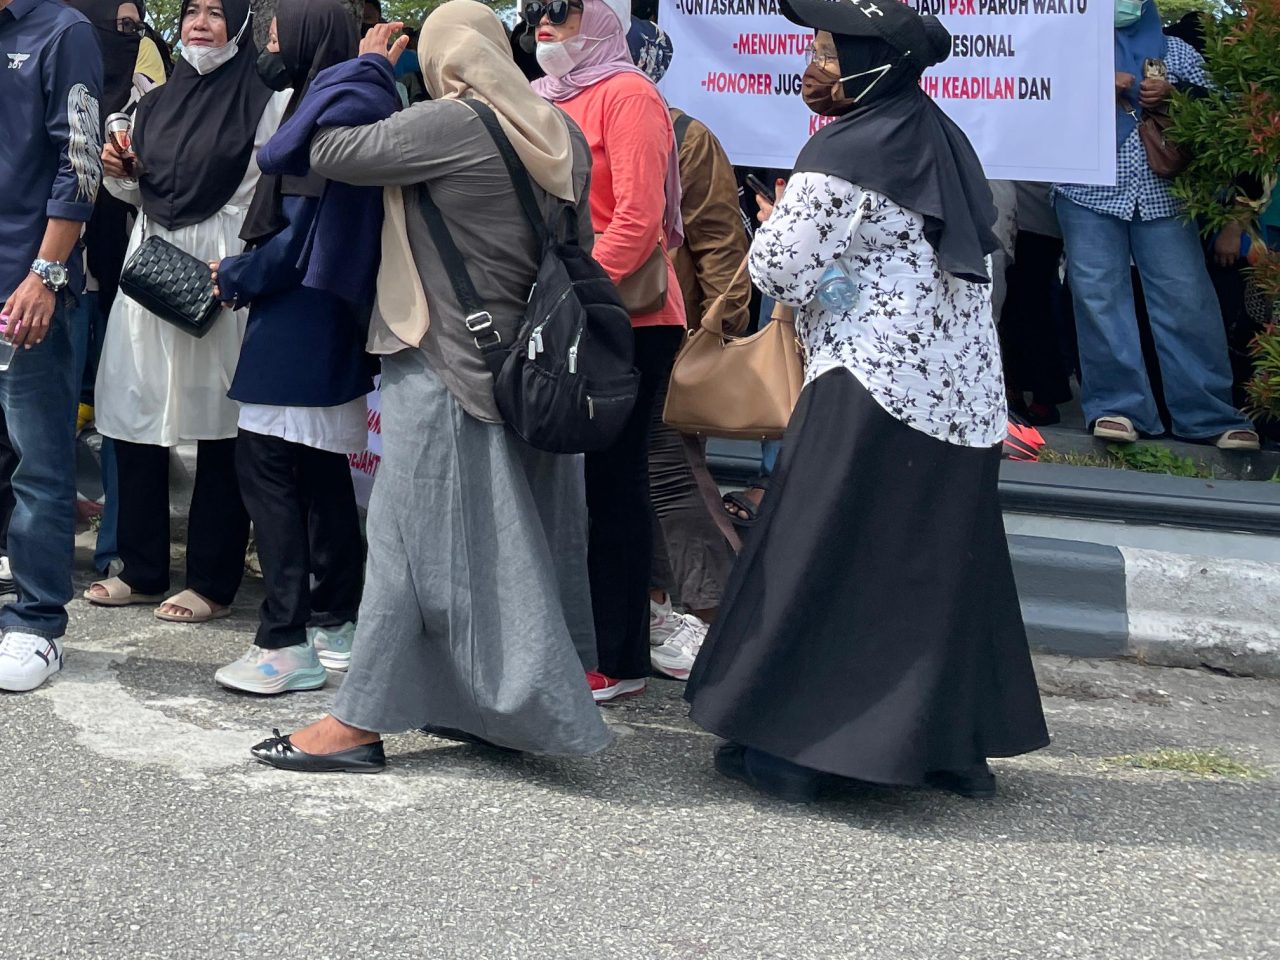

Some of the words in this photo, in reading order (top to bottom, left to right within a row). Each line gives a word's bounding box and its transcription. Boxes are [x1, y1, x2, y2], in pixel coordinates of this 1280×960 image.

[952, 34, 1015, 57] ESIONAL
[774, 73, 802, 96] JUG
[942, 76, 1015, 100] KEADILAN
[1018, 77, 1051, 100] DAN
